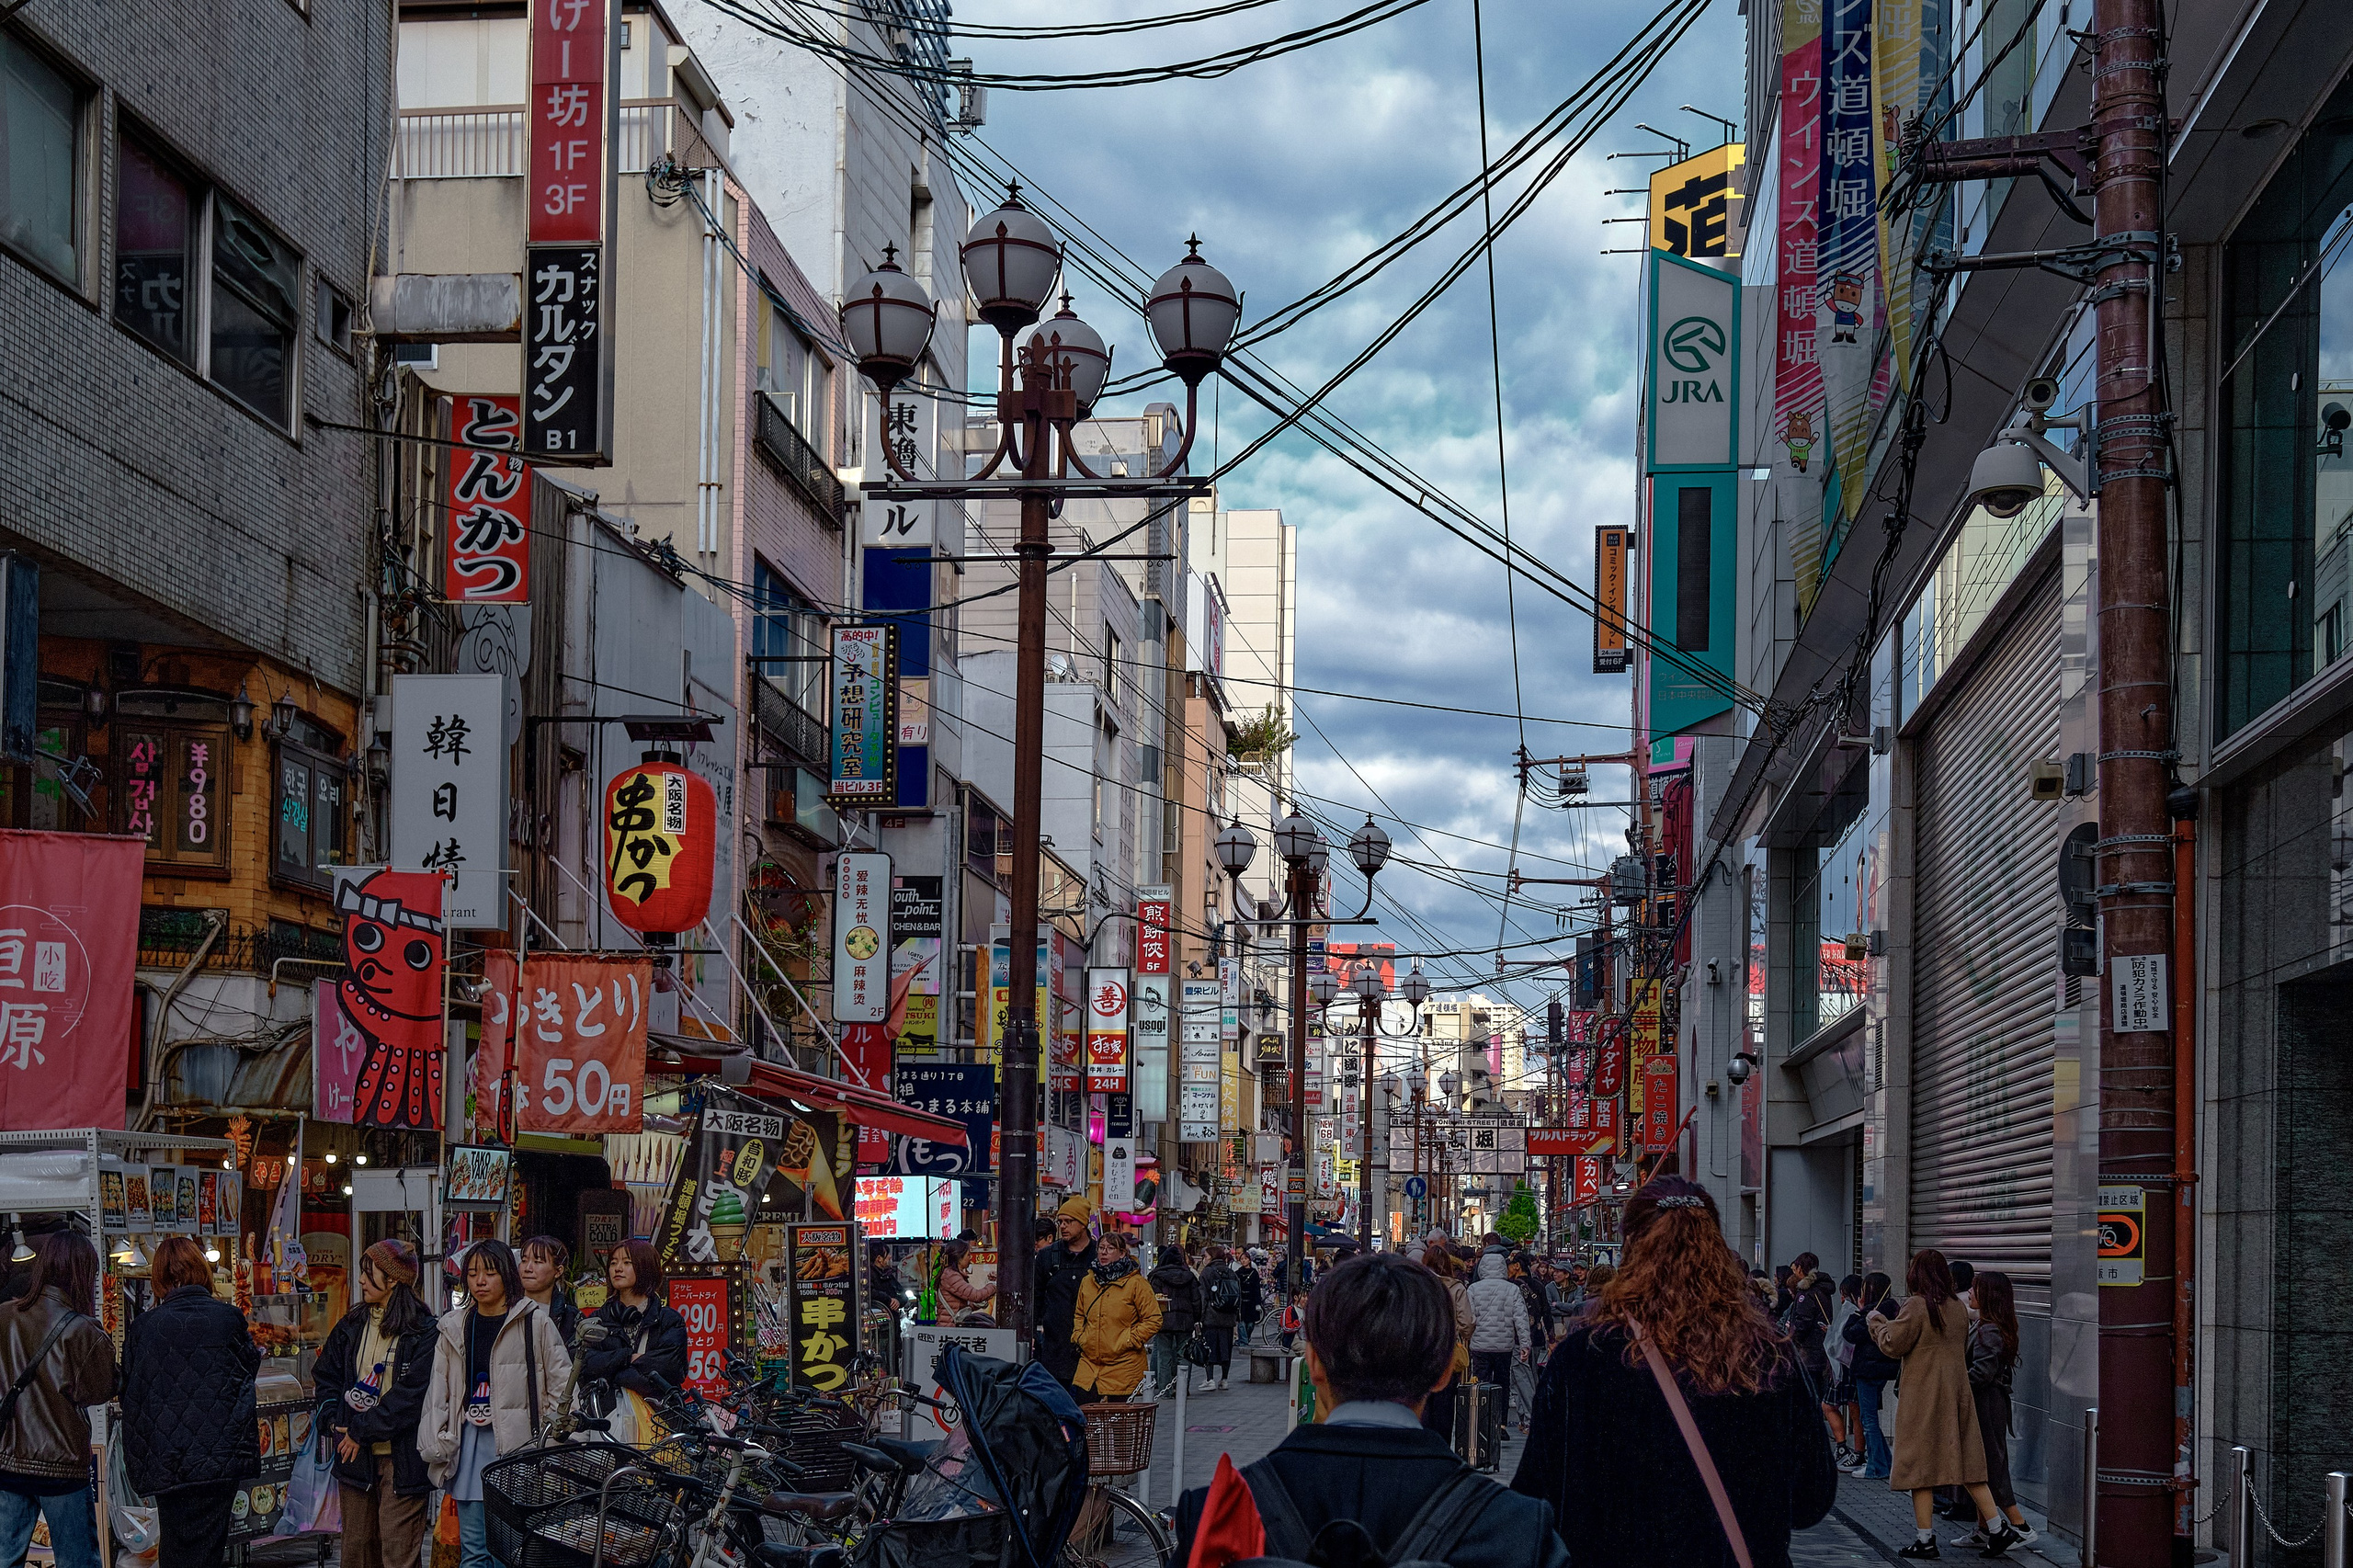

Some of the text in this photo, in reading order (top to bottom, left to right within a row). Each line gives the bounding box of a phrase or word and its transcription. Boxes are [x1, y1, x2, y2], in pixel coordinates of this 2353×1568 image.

[549, 141, 588, 170] 1F
[544, 184, 586, 214] 3F
[579, 253, 597, 340] スナック
[533, 265, 577, 422] カルダン
[1662, 380, 1724, 403] JRA
[546, 429, 576, 449] B1
[454, 398, 523, 597] とんかつ
[839, 664, 865, 778] 予想研究室
[189, 742, 210, 844] ¥980
[667, 777, 683, 828] 大阪名物
[884, 818, 904, 827] 4F
[610, 773, 670, 903] 串かつ
[892, 922, 941, 931] CHEN&BAR
[40, 946, 61, 991] 小吃
[1146, 961, 1161, 971] 5F
[1185, 985, 1220, 996] 豊栄ビル
[2131, 960, 2147, 1026] 防犯カメラ作動中
[870, 1007, 884, 1017] 2F
[1139, 1016, 1166, 1033] usagi
[1091, 1034, 1122, 1056] すき家
[1094, 1078, 1120, 1090] 24H
[1194, 1071, 1217, 1079] FUN
[542, 1059, 631, 1117] 50円
[1654, 1078, 1668, 1141] たこ焼き
[705, 1111, 780, 1138] 大阪名物
[1529, 1130, 1600, 1142] ツルハドラッグ
[472, 1151, 491, 1166] TAKO
[472, 1165, 488, 1180] YAKI
[1110, 1161, 1119, 1192] おむすび
[589, 1223, 618, 1233] EXTRA
[589, 1232, 618, 1242] COLD
[801, 1230, 841, 1243] 大阪名物
[673, 1291, 718, 1300] スーパードライ
[801, 1296, 849, 1392] 串かつ
